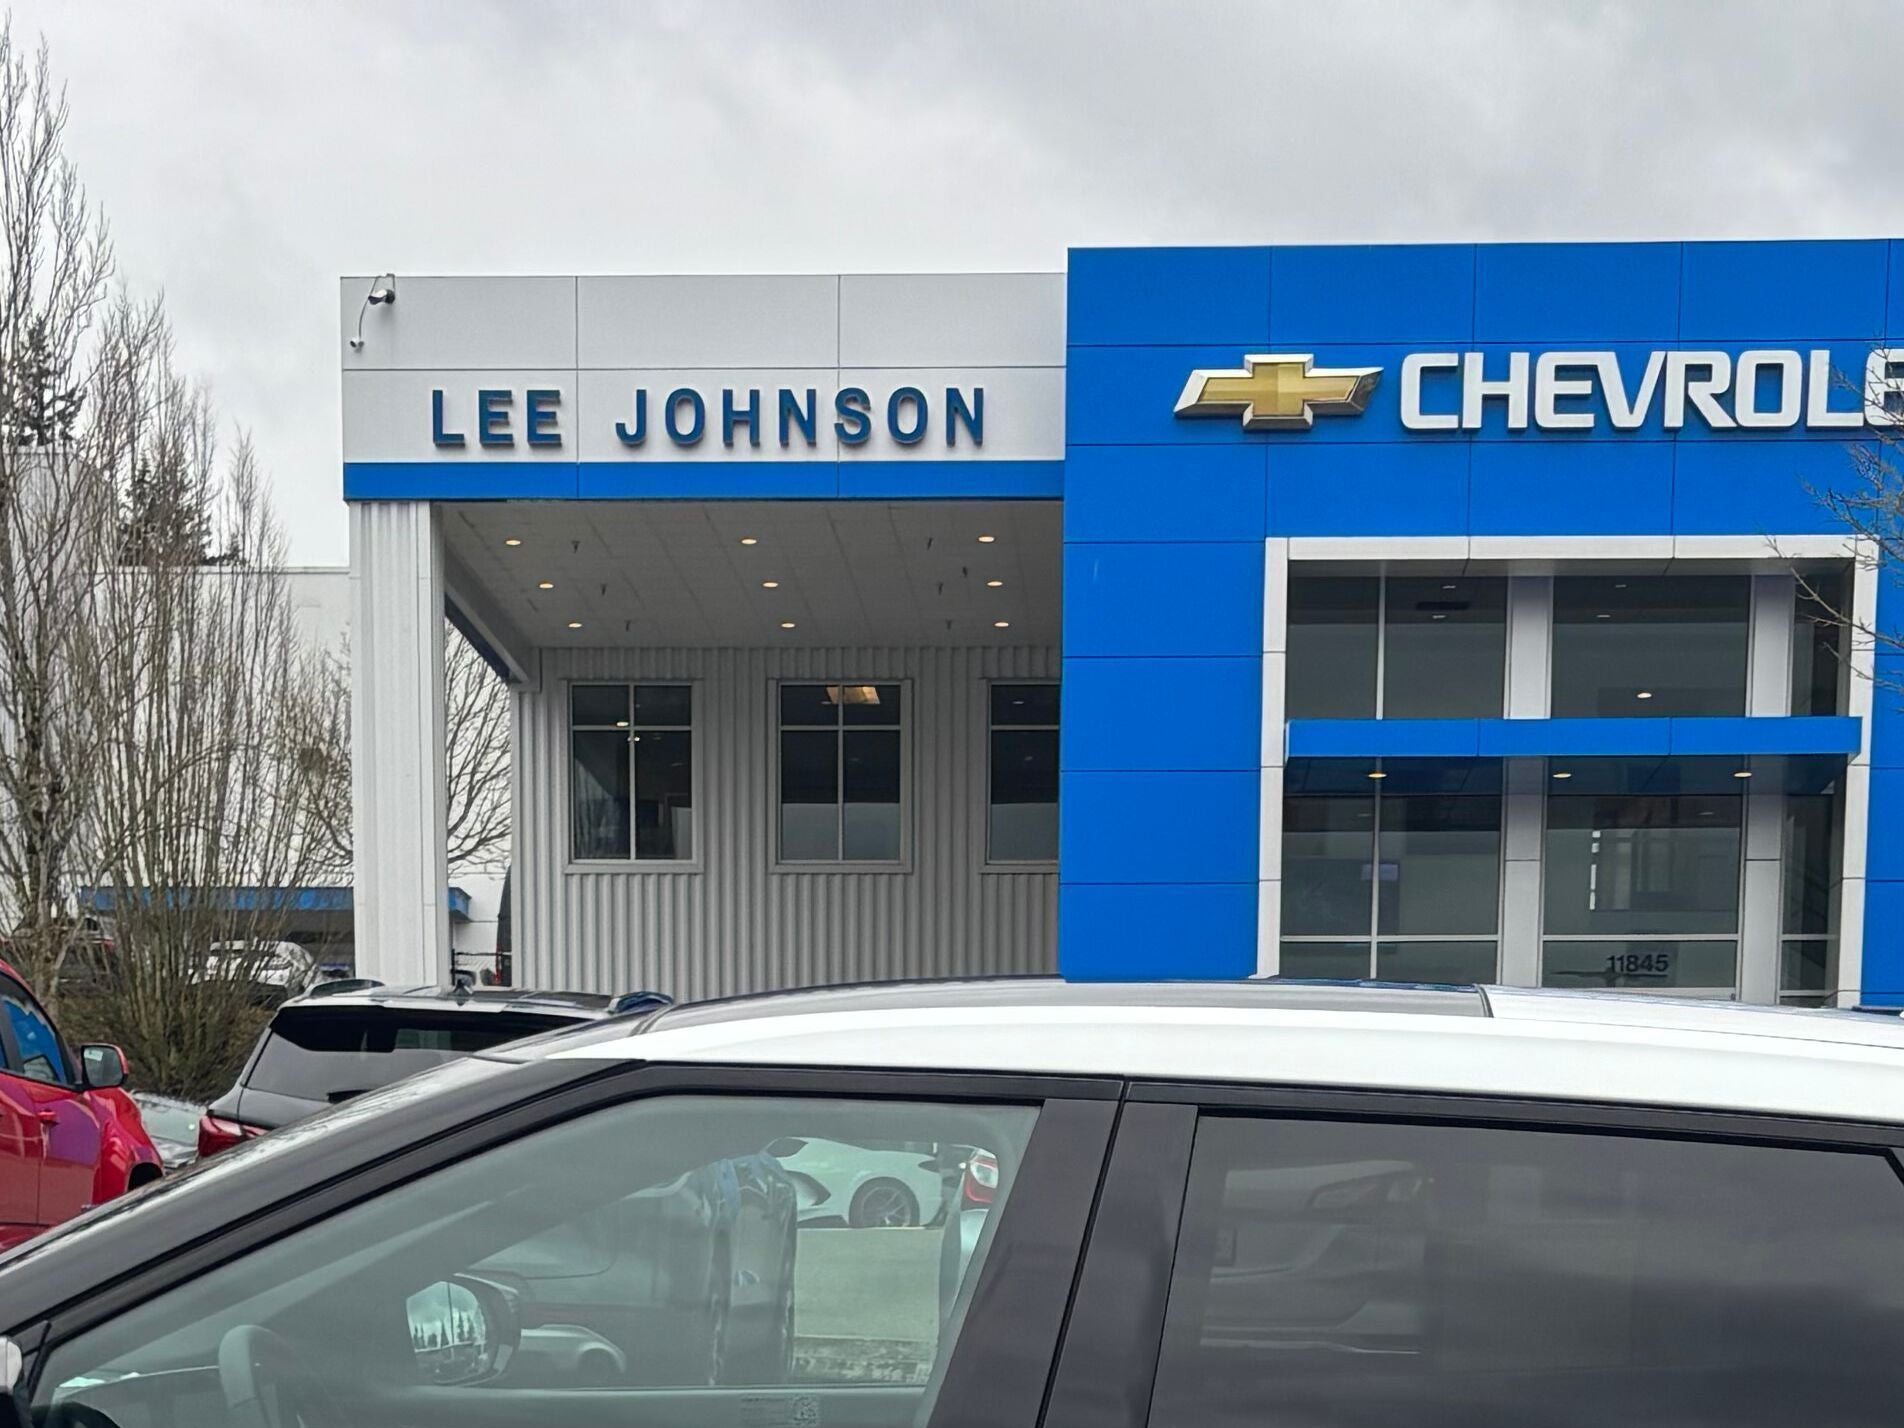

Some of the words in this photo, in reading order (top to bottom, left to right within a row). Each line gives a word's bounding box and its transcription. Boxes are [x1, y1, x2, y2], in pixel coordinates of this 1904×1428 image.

[431, 388, 563, 447] LEE
[615, 385, 986, 447] JOHNSON
[1607, 954, 1669, 973] 11845
